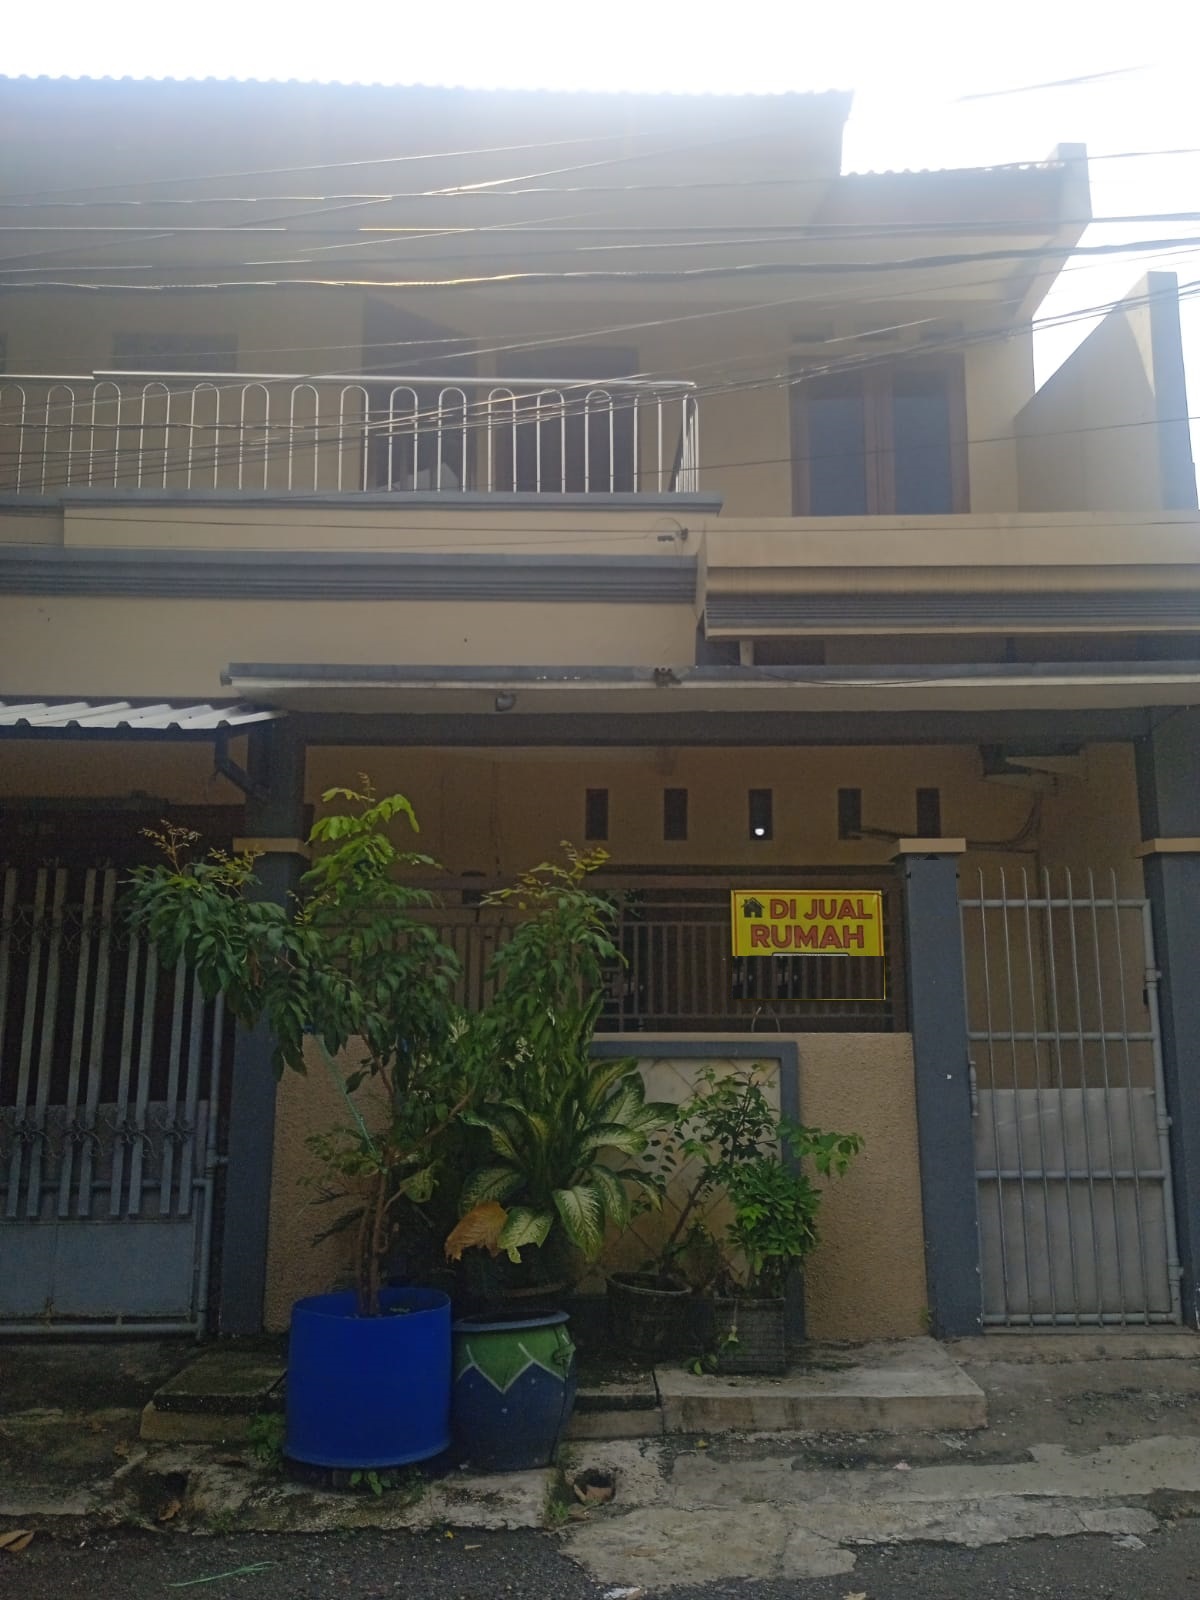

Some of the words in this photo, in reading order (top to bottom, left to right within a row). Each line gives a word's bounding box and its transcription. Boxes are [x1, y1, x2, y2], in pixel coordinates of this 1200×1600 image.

[770, 899, 797, 920] DI
[803, 899, 873, 920] JUAL
[750, 924, 865, 949] RUMAH
